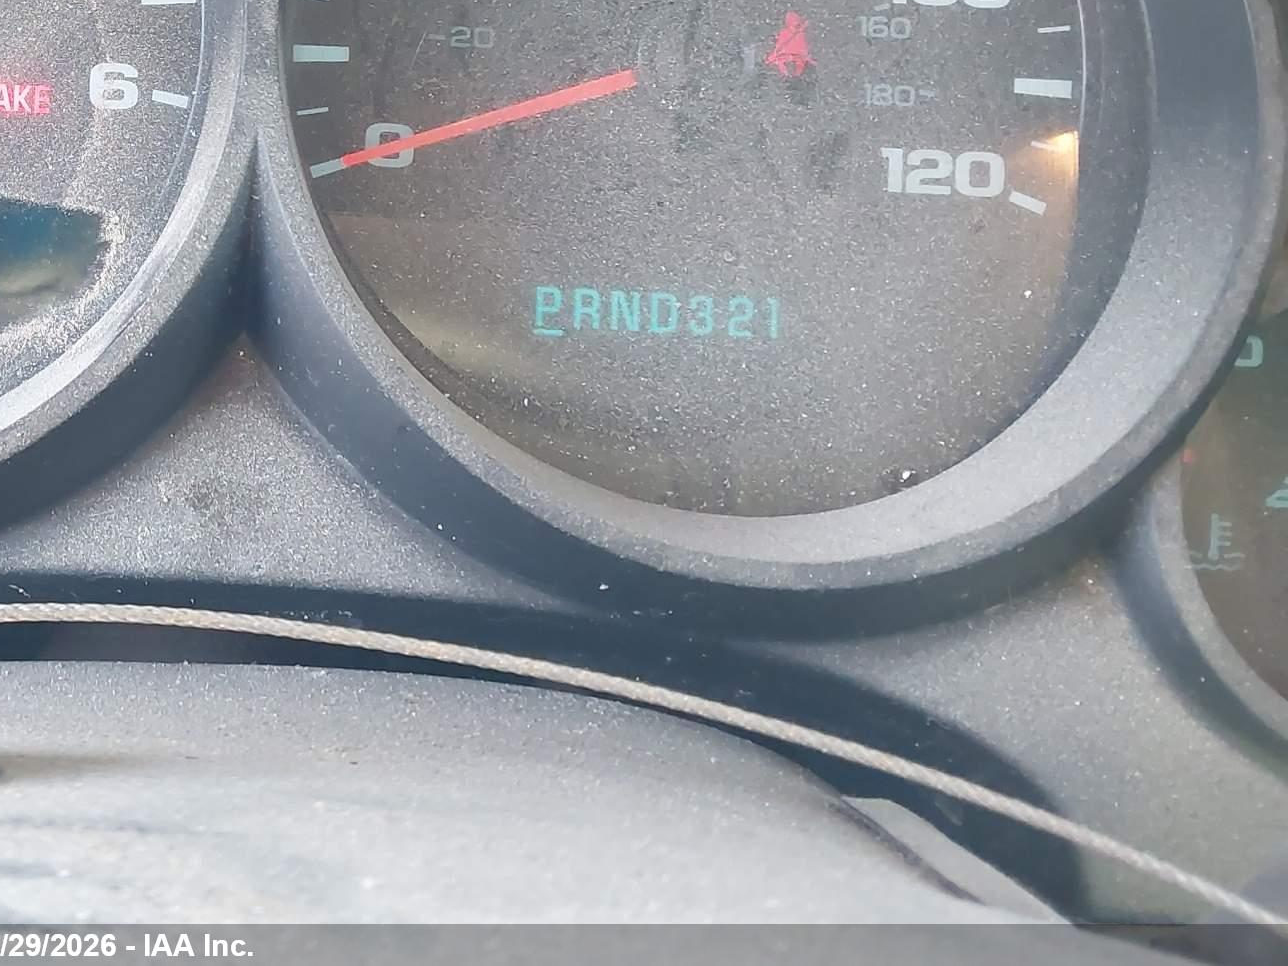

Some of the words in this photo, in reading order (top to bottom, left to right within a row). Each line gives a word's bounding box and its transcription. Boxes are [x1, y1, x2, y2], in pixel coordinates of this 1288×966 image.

[450, 26, 494, 49] 20
[859, 16, 912, 39] 160
[89, 63, 140, 111] 6
[863, 83, 916, 107] 180
[365, 123, 415, 169] 0
[880, 147, 1005, 198] 120
